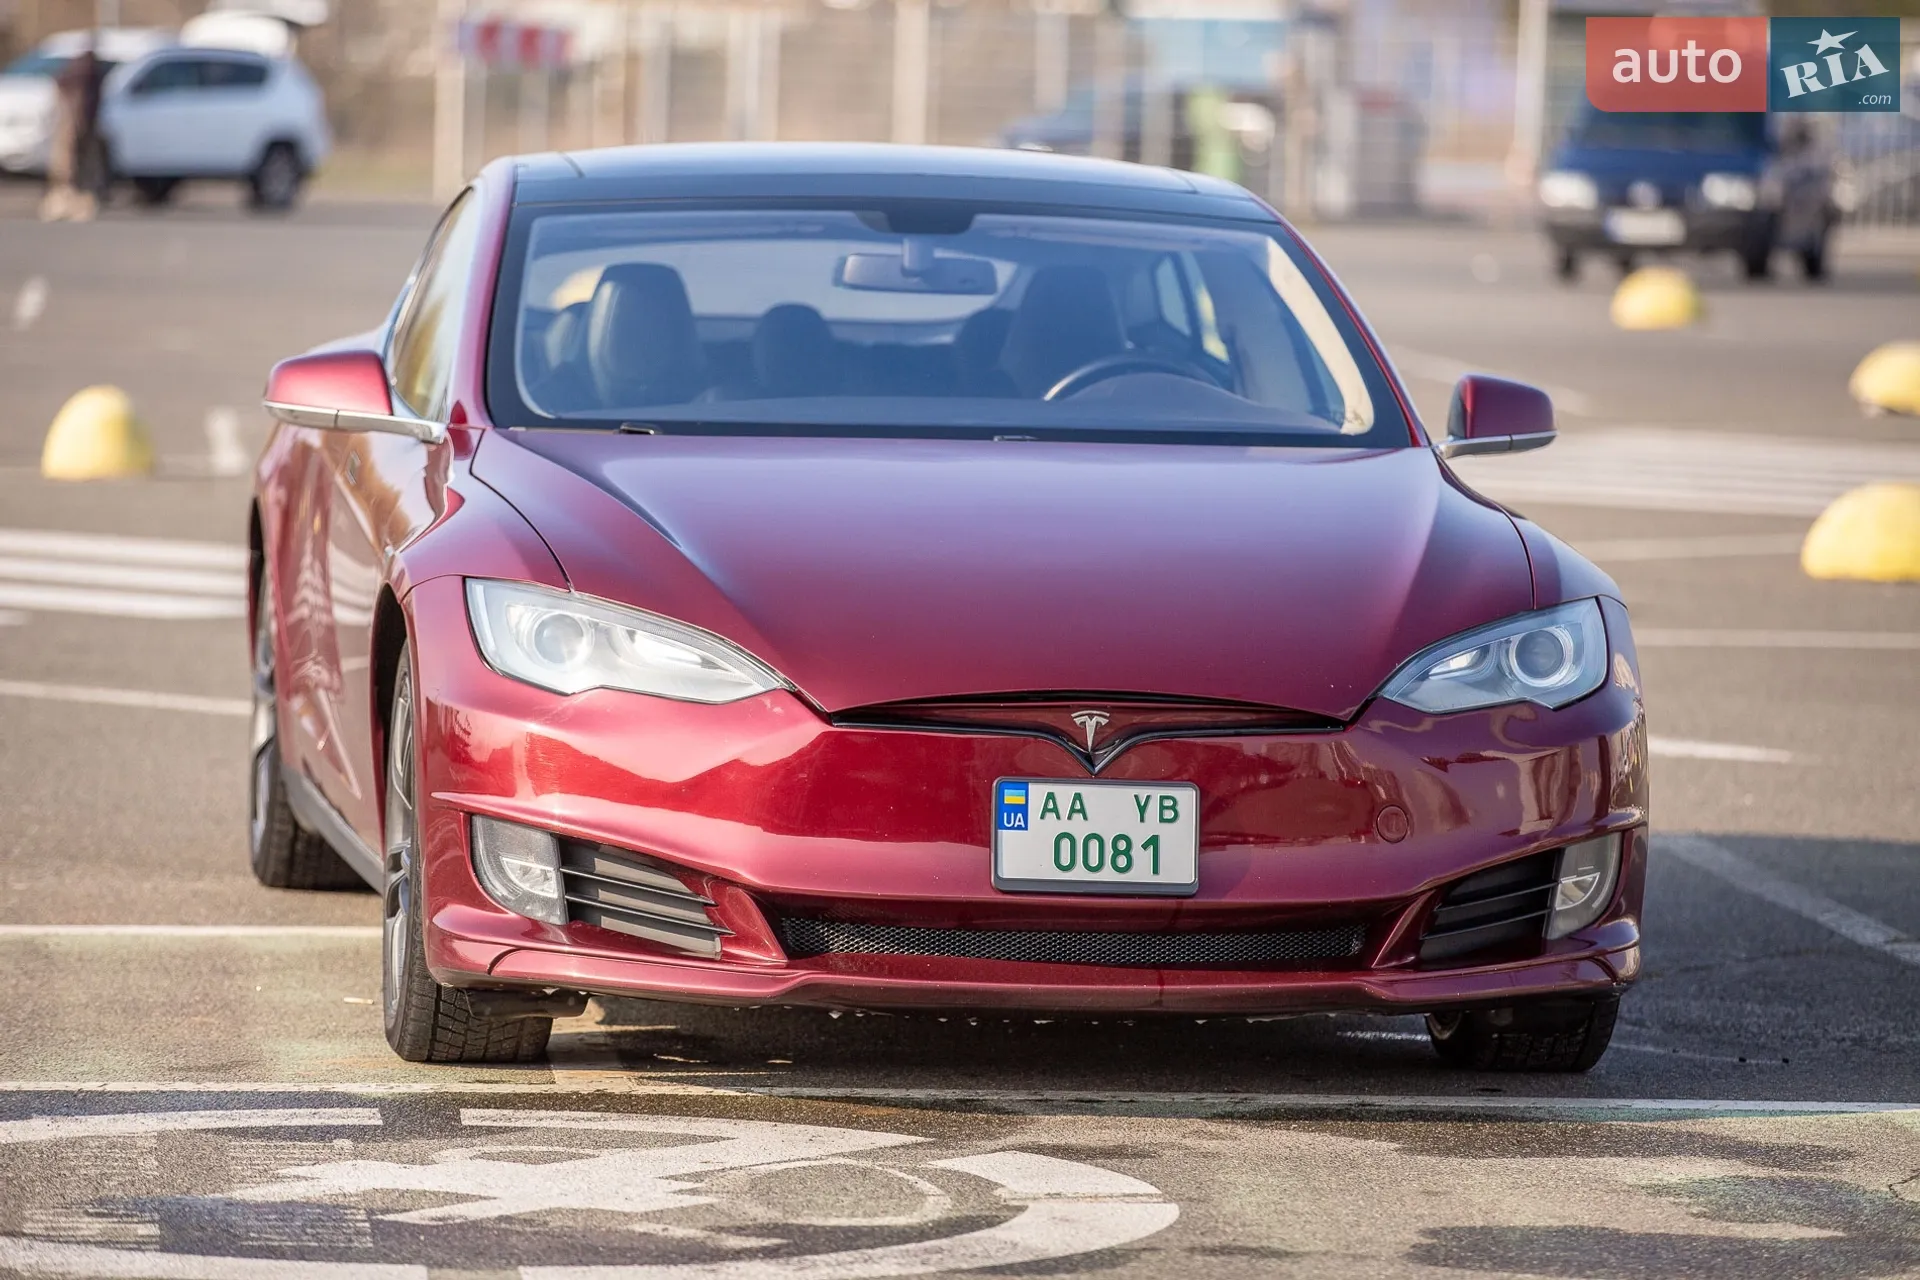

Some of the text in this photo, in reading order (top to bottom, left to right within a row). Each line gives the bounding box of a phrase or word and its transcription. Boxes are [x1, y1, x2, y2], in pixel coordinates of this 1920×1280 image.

[1003, 812, 1025, 828] UA
[1039, 791, 1180, 823] AA YB
[1053, 831, 1161, 875] 0081
